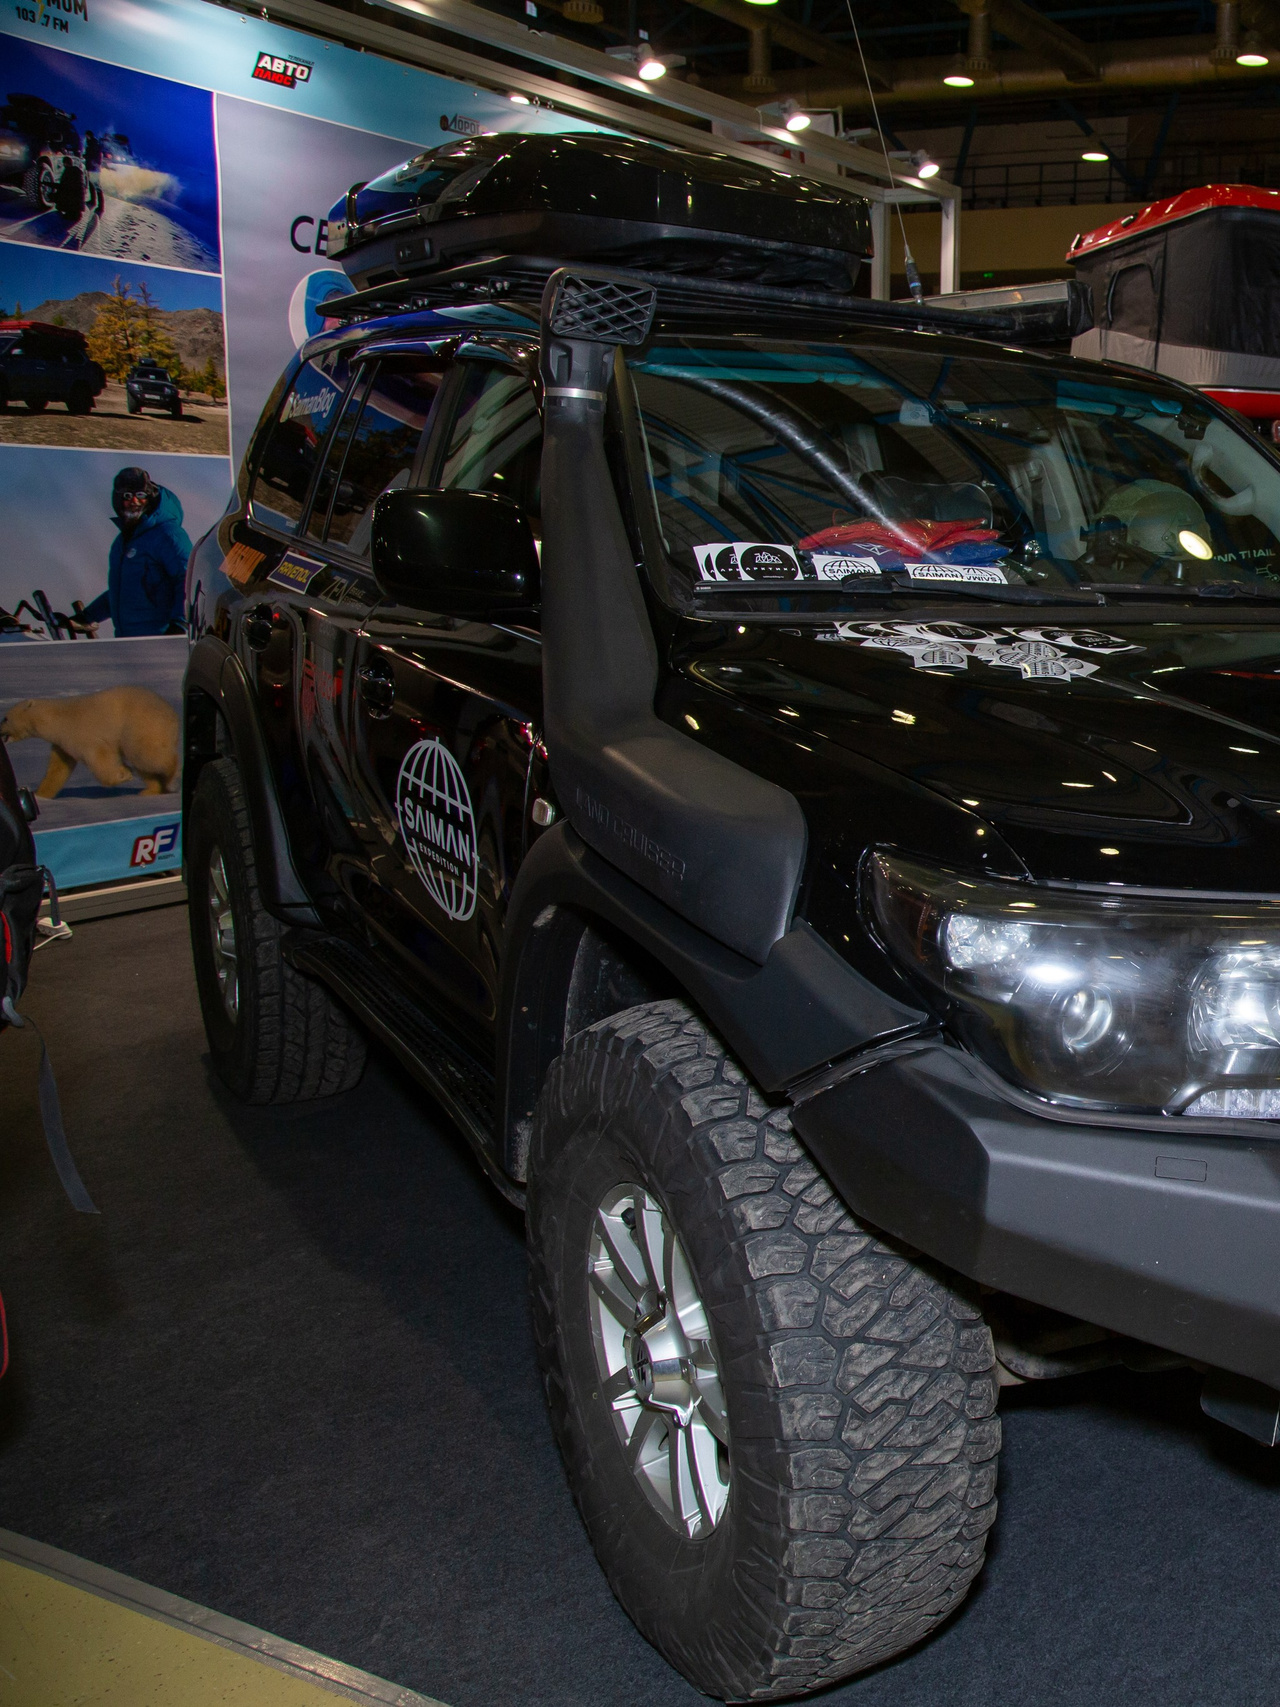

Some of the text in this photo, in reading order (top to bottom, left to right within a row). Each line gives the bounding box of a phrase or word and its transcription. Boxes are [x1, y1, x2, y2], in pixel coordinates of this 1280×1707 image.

[53, 17, 69, 33] FM
[258, 54, 309, 80] АВТО
[135, 829, 174, 863] RF
[419, 842, 460, 877] EXPEDITION
